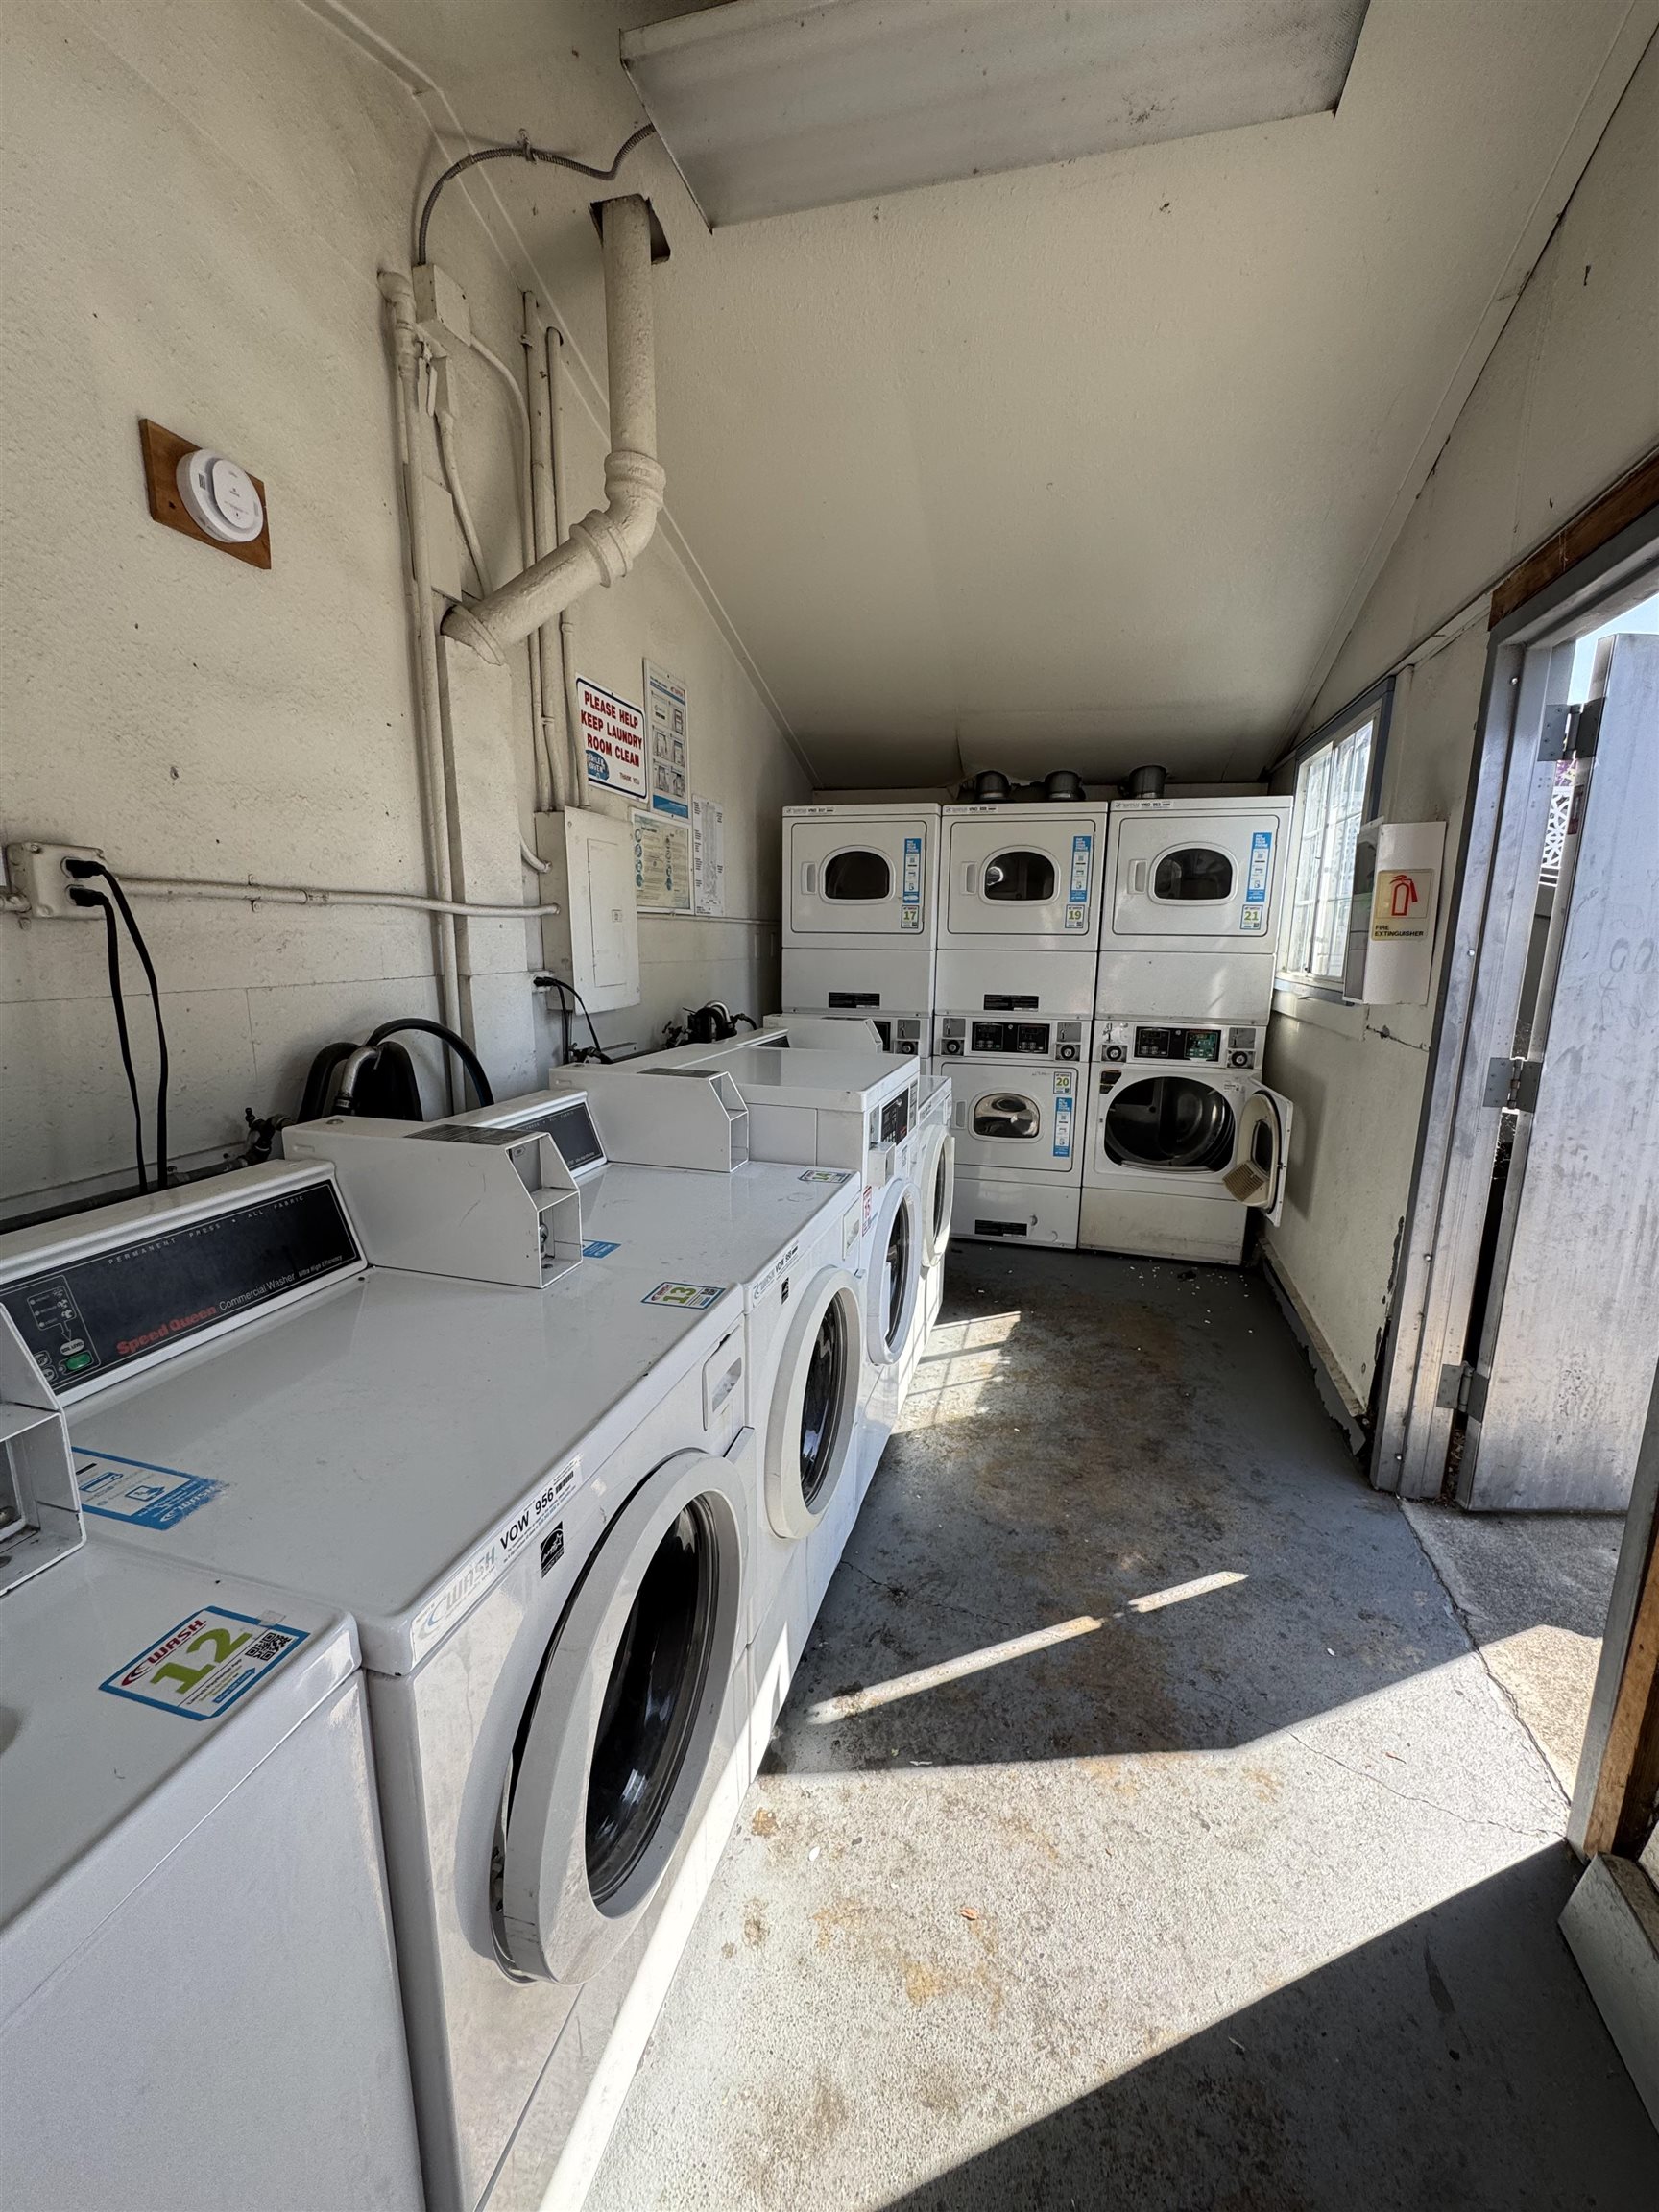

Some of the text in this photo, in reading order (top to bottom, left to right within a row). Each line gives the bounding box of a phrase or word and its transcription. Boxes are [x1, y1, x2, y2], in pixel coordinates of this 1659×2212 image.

[584, 690, 616, 719] PLEASE
[619, 709, 638, 729] HELP
[581, 709, 642, 750] KEEP LAUNDRY
[587, 733, 639, 767] ROOM CLEAN
[904, 911, 917, 920] 17
[1069, 910, 1081, 920] 19
[1244, 911, 1259, 921] 21
[1056, 1077, 1070, 1087] 20
[108, 1195, 304, 1264] PERMANENT PRESS ALL FABRIC
[116, 1255, 343, 1356] Speed Queen Commercial Washer Ultra High Efficiency
[663, 1286, 697, 1304] 13
[446, 1546, 495, 1611] WASH
[500, 1510, 530, 1550] VOW
[535, 1487, 554, 1515] 956
[147, 1620, 204, 1666] WASH
[150, 1628, 253, 1694] 12
